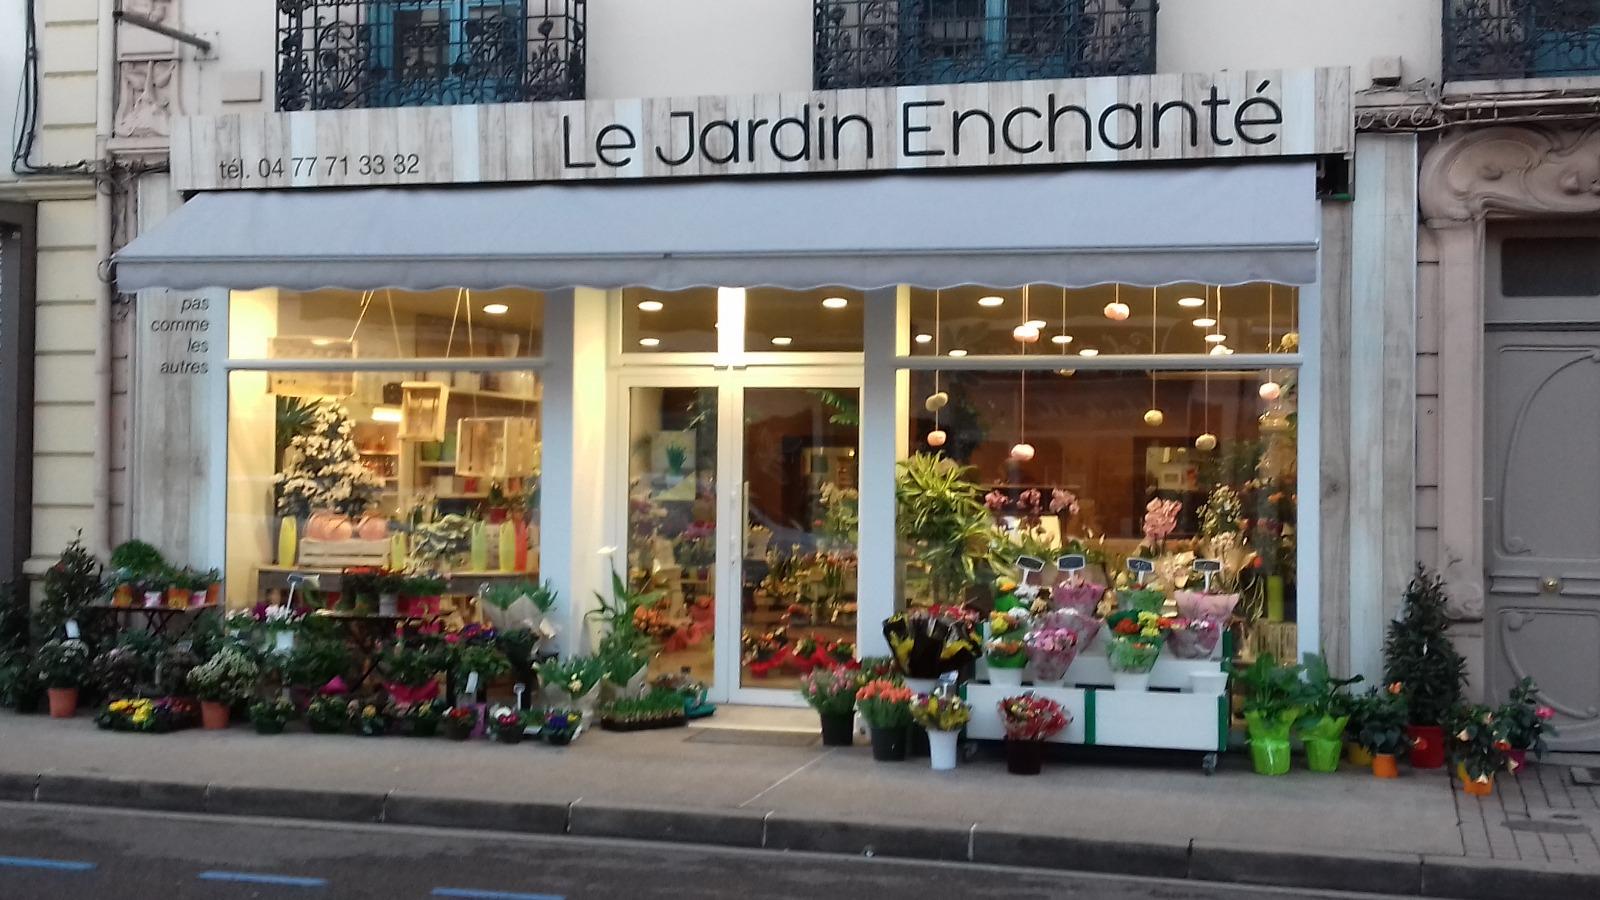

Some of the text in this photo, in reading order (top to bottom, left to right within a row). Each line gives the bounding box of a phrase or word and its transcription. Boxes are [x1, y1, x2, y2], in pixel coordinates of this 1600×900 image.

[563, 79, 1283, 169] Le Jardin Enchanté
[219, 154, 420, 180] tél. 04 77 71 33 32
[181, 299, 209, 314] pas
[151, 319, 209, 332] comme
[187, 338, 209, 353] les
[160, 360, 209, 374] autres
